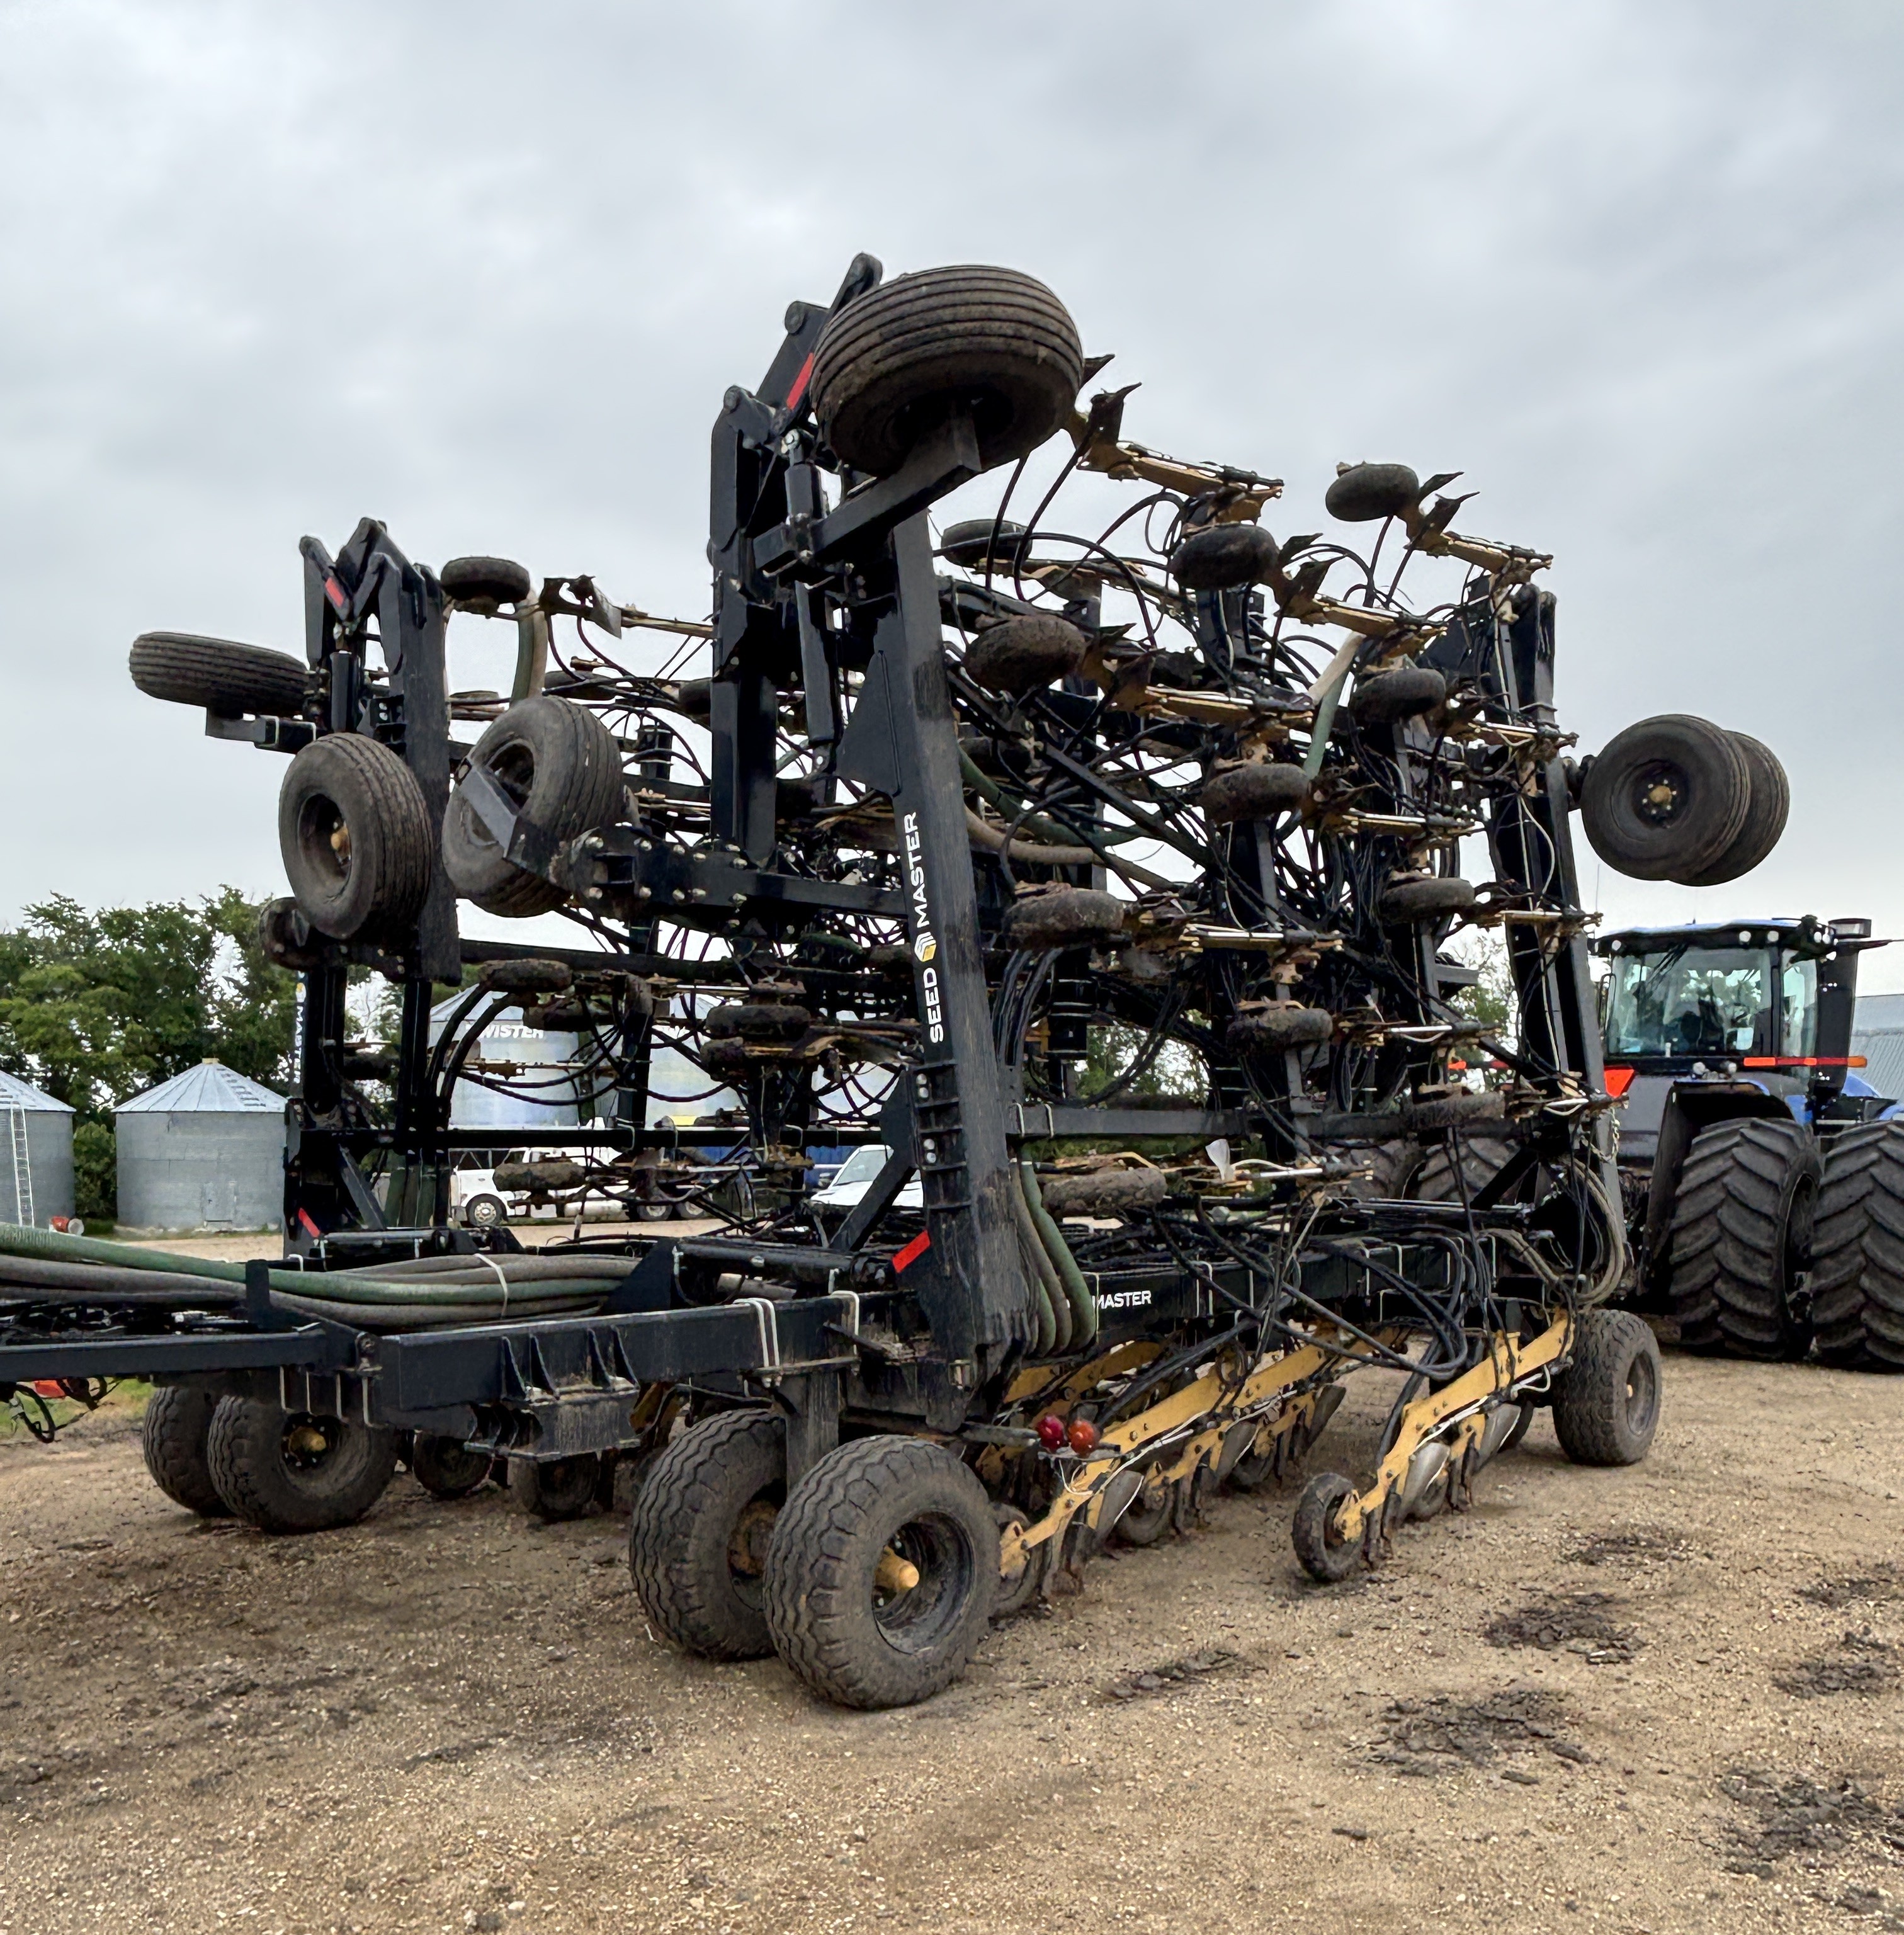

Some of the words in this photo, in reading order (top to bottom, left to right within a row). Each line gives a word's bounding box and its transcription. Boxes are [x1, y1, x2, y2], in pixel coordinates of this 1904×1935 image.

[904, 811, 930, 929] MASTER
[923, 967, 944, 1043] SEED
[465, 1024, 544, 1039] WISTER
[1092, 1290, 1152, 1310] MASTER
